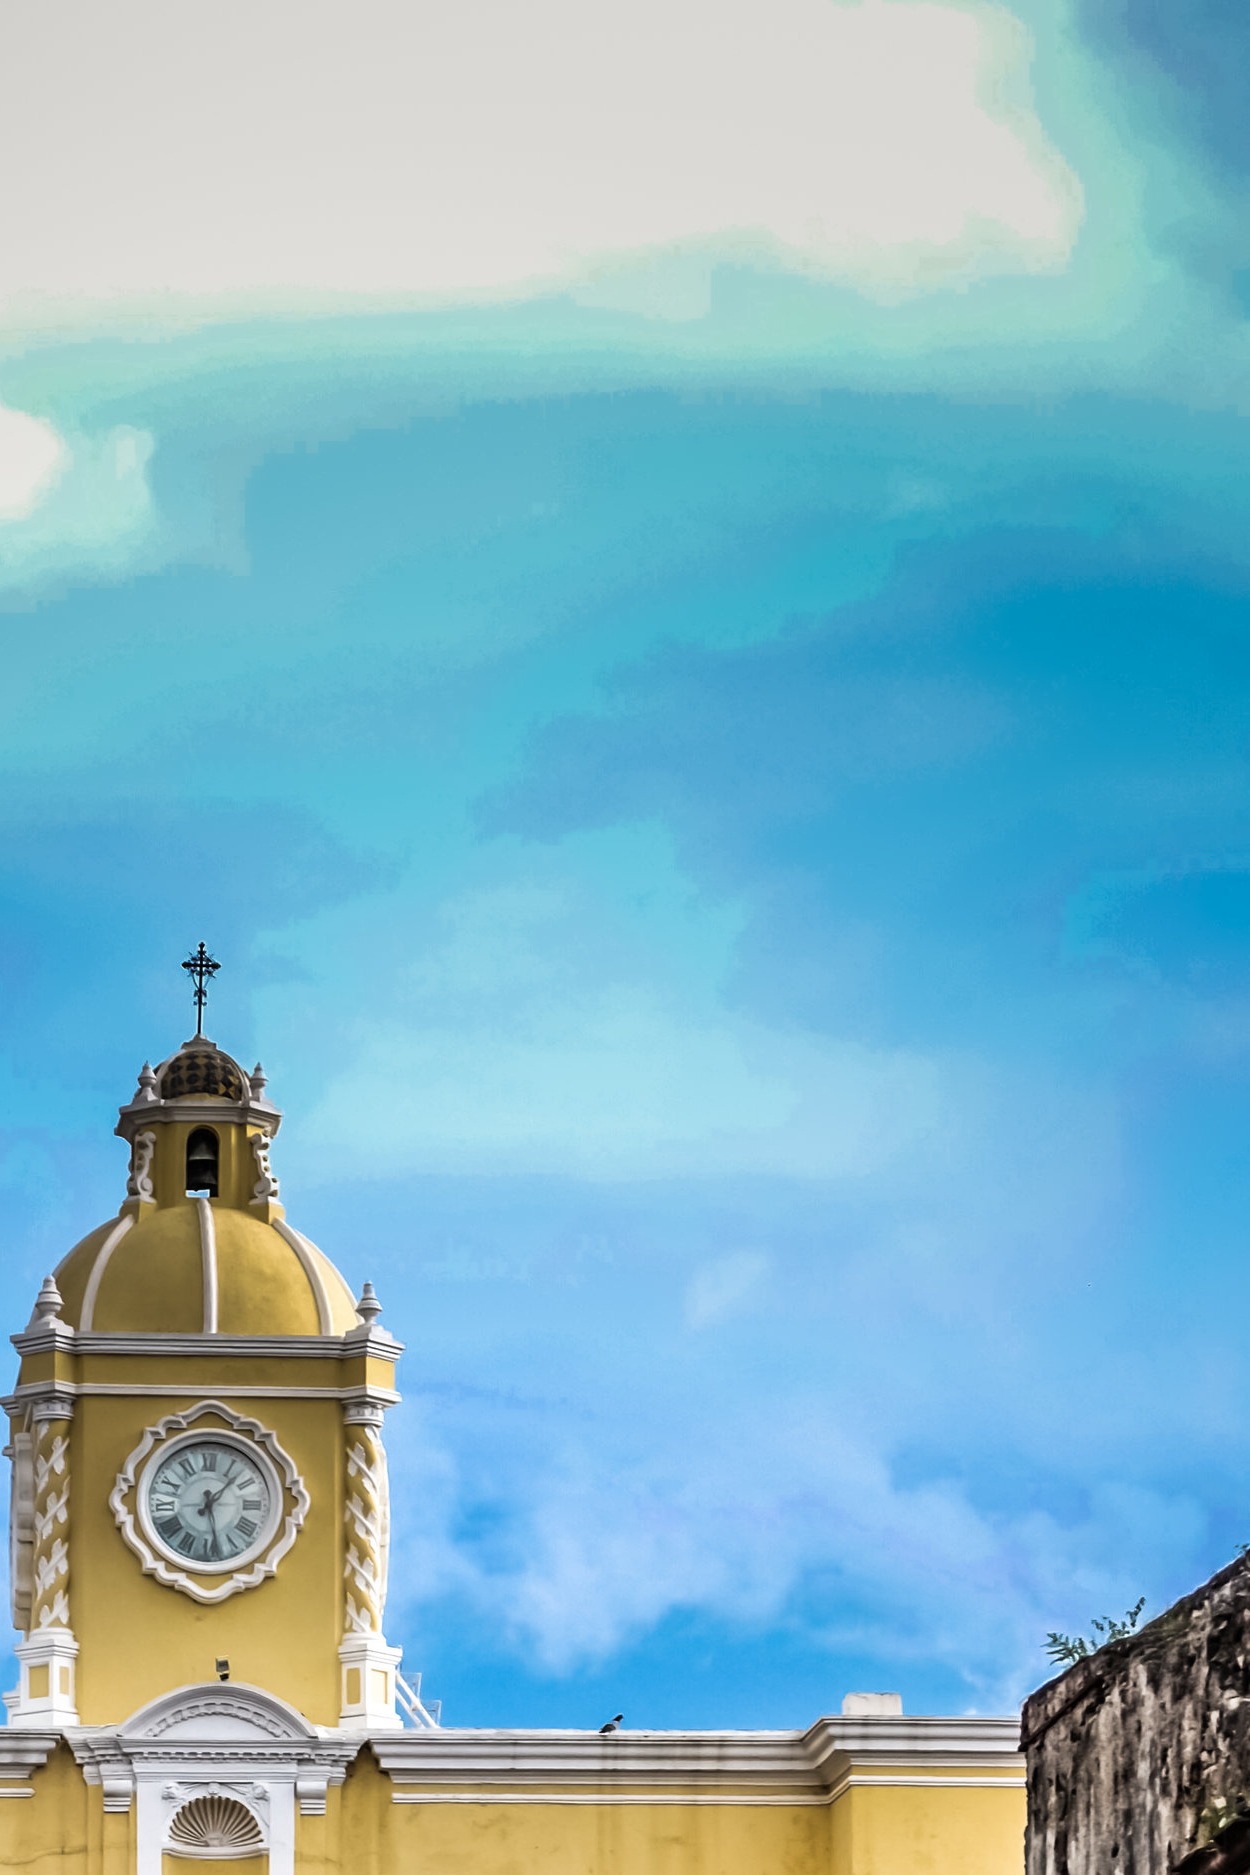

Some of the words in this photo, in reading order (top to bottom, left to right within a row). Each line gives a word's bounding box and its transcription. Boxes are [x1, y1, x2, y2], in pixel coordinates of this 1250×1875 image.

[222, 1459, 237, 1477] I
[161, 1475, 181, 1492] X
[236, 1477, 255, 1491] II
[155, 1498, 175, 1512] IX
[242, 1499, 261, 1511] III
